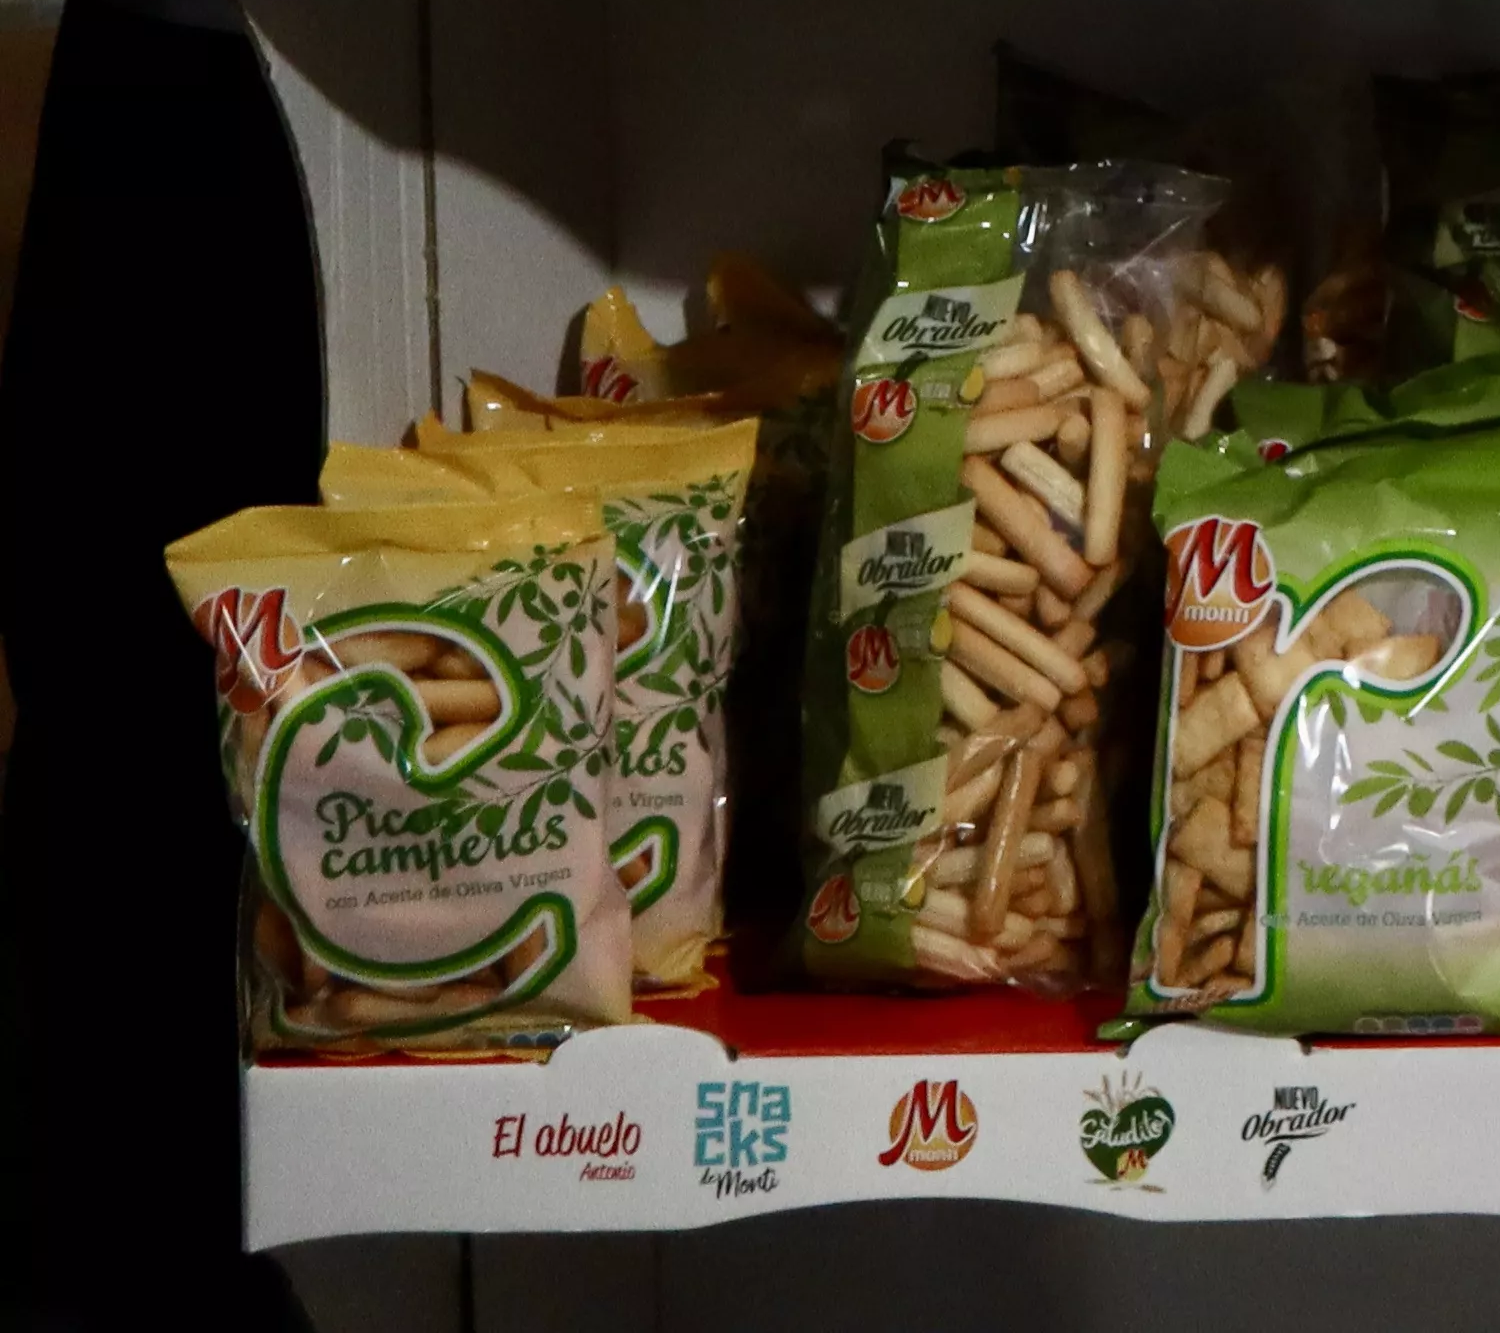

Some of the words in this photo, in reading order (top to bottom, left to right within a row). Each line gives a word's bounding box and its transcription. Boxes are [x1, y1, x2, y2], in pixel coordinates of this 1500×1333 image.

[883, 313, 1007, 342] Obrador
[858, 547, 964, 586] Obrador
[830, 806, 935, 836] Obrador
[320, 814, 569, 881] camperos
[364, 887, 423, 909] Aceite
[430, 885, 452, 901] de
[456, 880, 503, 900] Oliva
[509, 866, 573, 890] Virgen
[1274, 1086, 1319, 1110] NUEVO
[492, 1115, 523, 1159] El
[534, 1112, 642, 1159] abuelo
[1241, 1099, 1357, 1141] Obrador
[579, 1161, 636, 1182] Antonio
[716, 1168, 780, 1199] Monti
